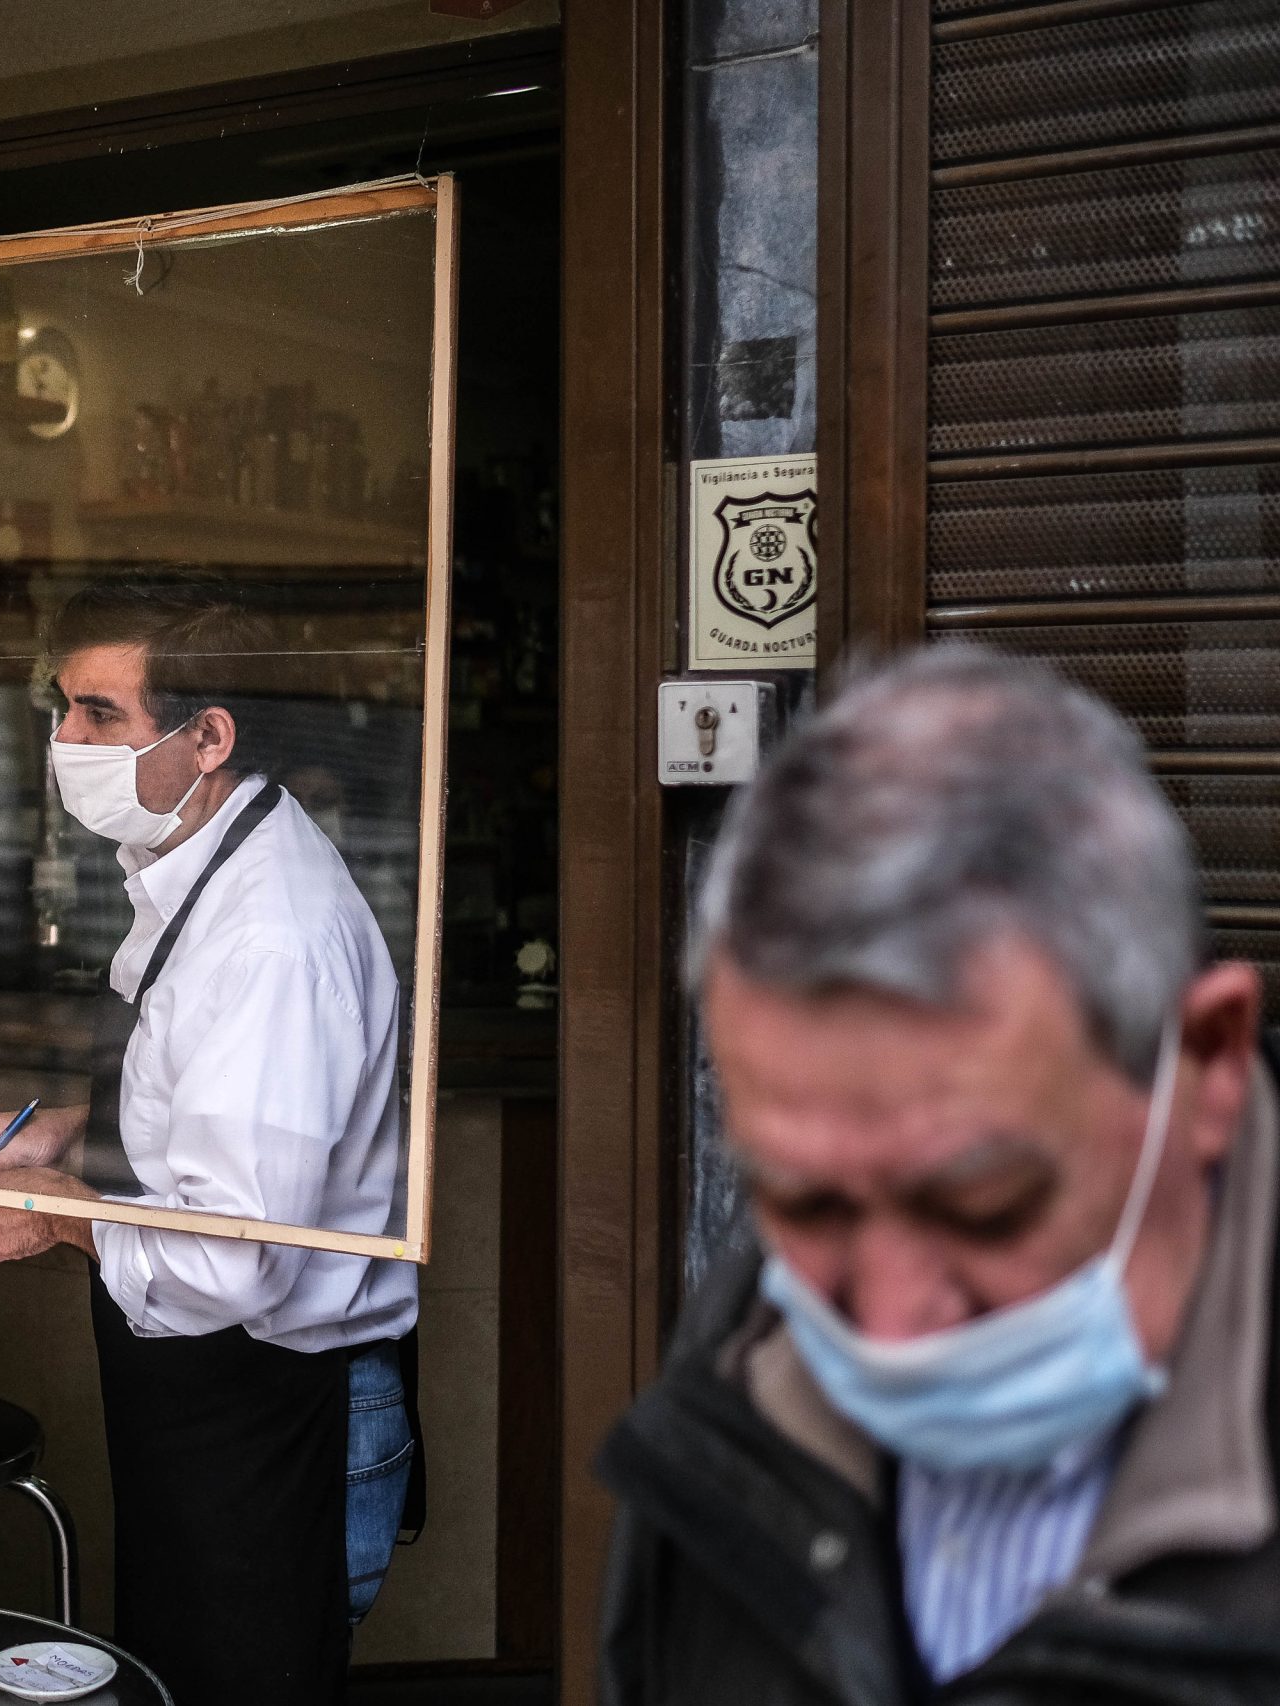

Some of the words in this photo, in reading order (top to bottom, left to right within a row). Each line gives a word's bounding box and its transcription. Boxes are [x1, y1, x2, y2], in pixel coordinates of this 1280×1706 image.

[701, 470, 758, 485] Vigilância
[762, 470, 769, 480] e
[743, 566, 795, 587] GN
[709, 628, 758, 653] GUARDA
[668, 763, 699, 771] ACM
